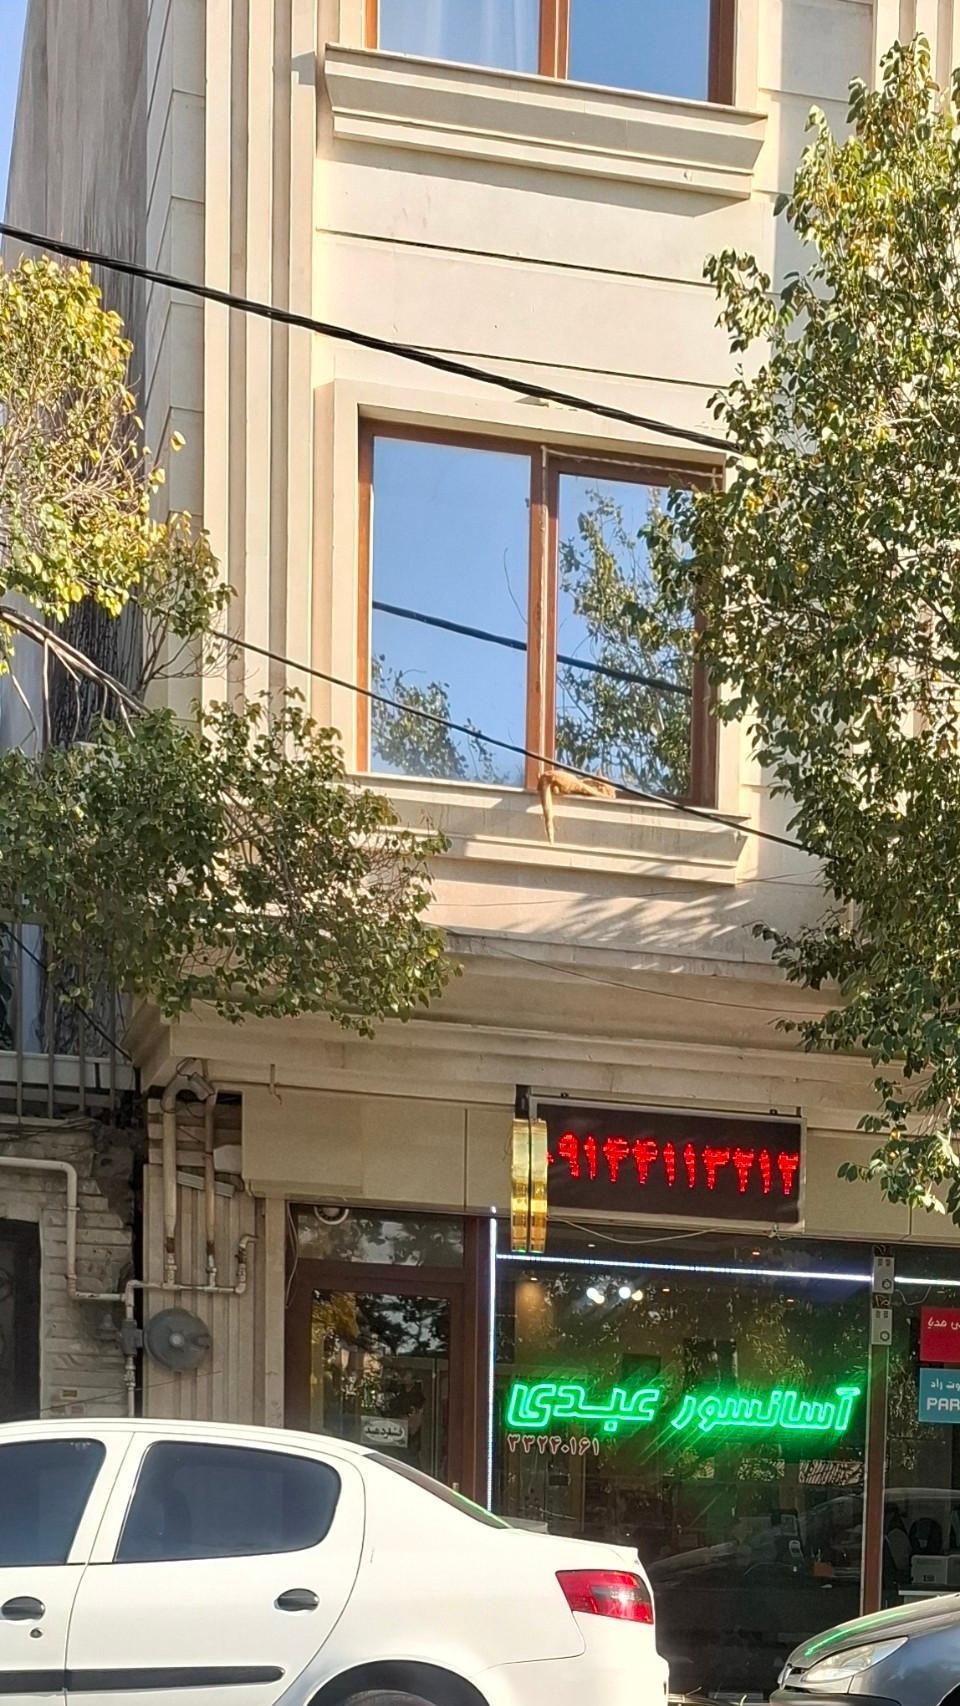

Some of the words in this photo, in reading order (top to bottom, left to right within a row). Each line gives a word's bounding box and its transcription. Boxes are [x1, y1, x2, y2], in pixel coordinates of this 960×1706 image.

[930, 1378, 943, 1391] راد
[506, 1382, 661, 1433] عبدی
[670, 1386, 862, 1432] آسانسور
[507, 1433, 600, 1456] ۳۳۲۴۰۱۶۱
